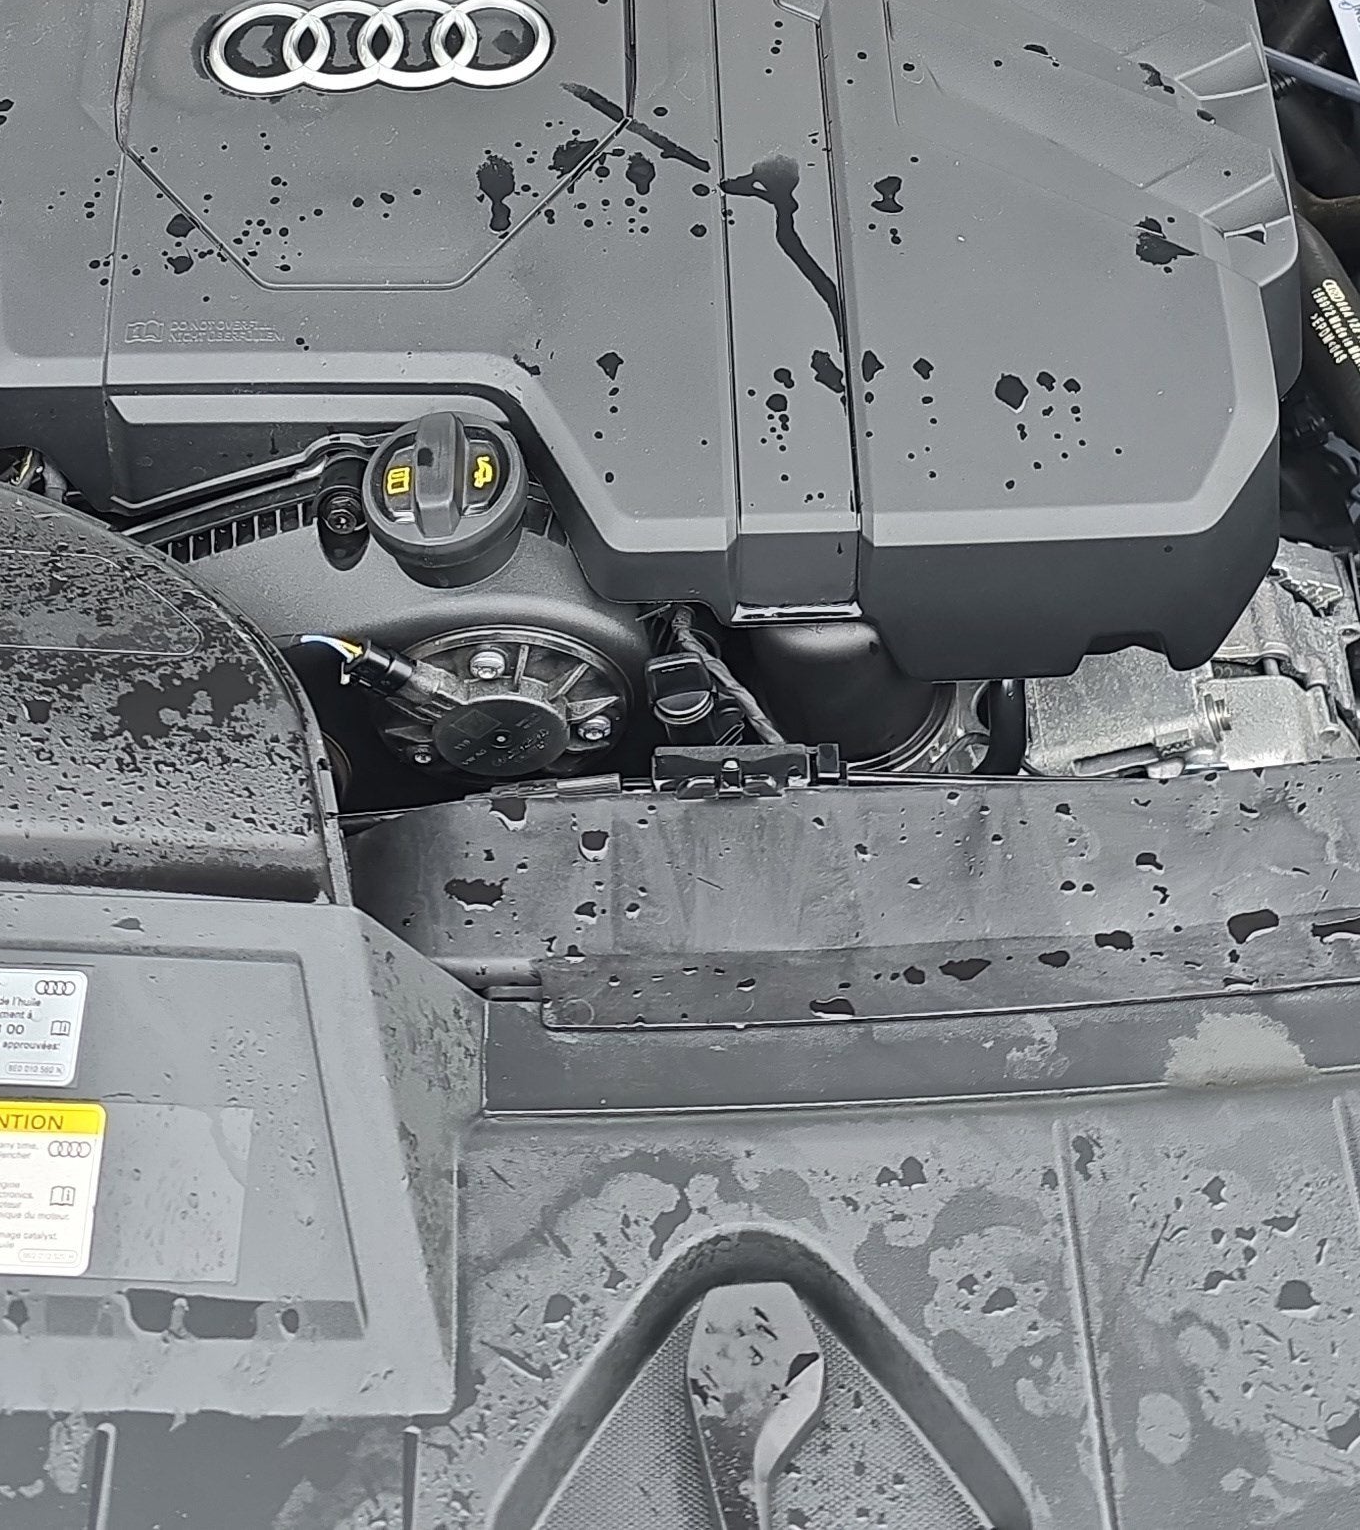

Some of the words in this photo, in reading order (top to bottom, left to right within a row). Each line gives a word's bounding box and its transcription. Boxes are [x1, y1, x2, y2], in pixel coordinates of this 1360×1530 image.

[171, 321, 188, 331] DO
[190, 321, 216, 331] NOT
[1328, 315, 1347, 338] Made
[169, 332, 206, 343] NICHT
[6, 1024, 25, 1035] 00
[0, 1142, 15, 1150] any
